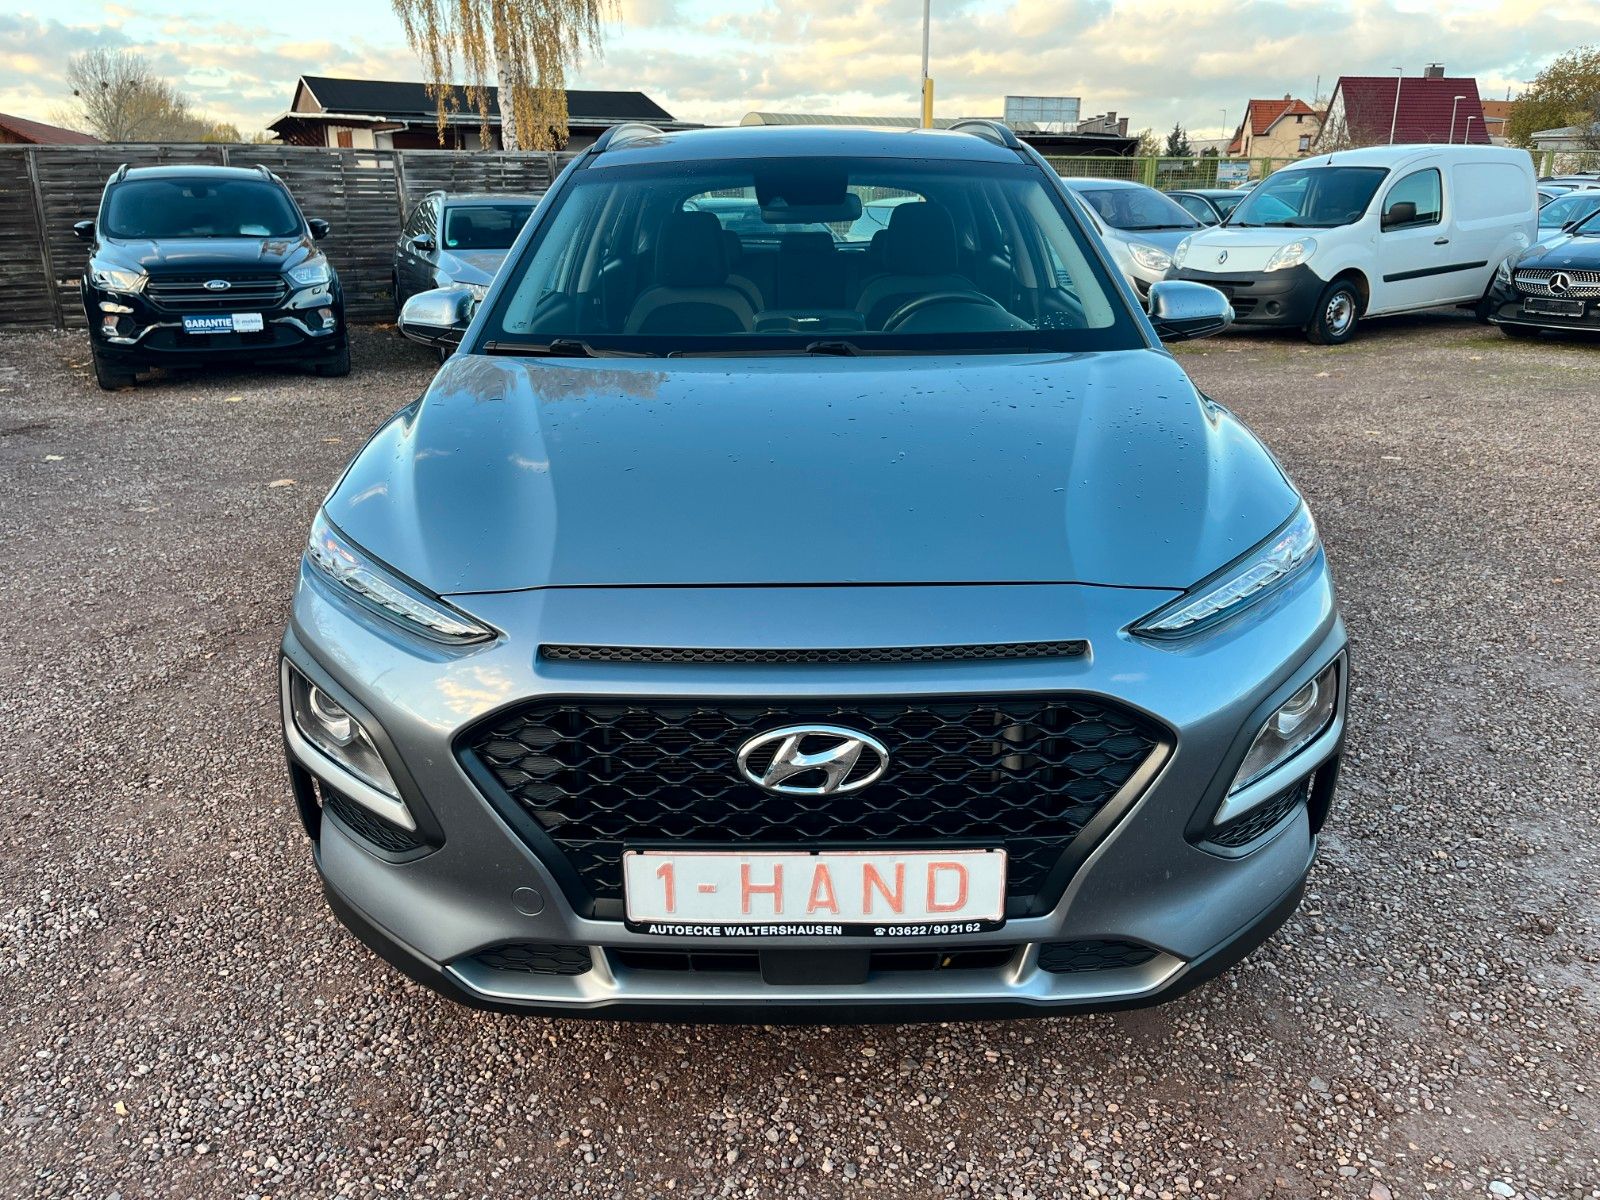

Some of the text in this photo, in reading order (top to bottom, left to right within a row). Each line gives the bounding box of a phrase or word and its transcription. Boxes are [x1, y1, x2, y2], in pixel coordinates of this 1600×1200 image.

[185, 318, 232, 328] GARANTIE
[648, 924, 721, 936] AUTOECKE
[724, 925, 842, 936] WALTERSHAUSEN
